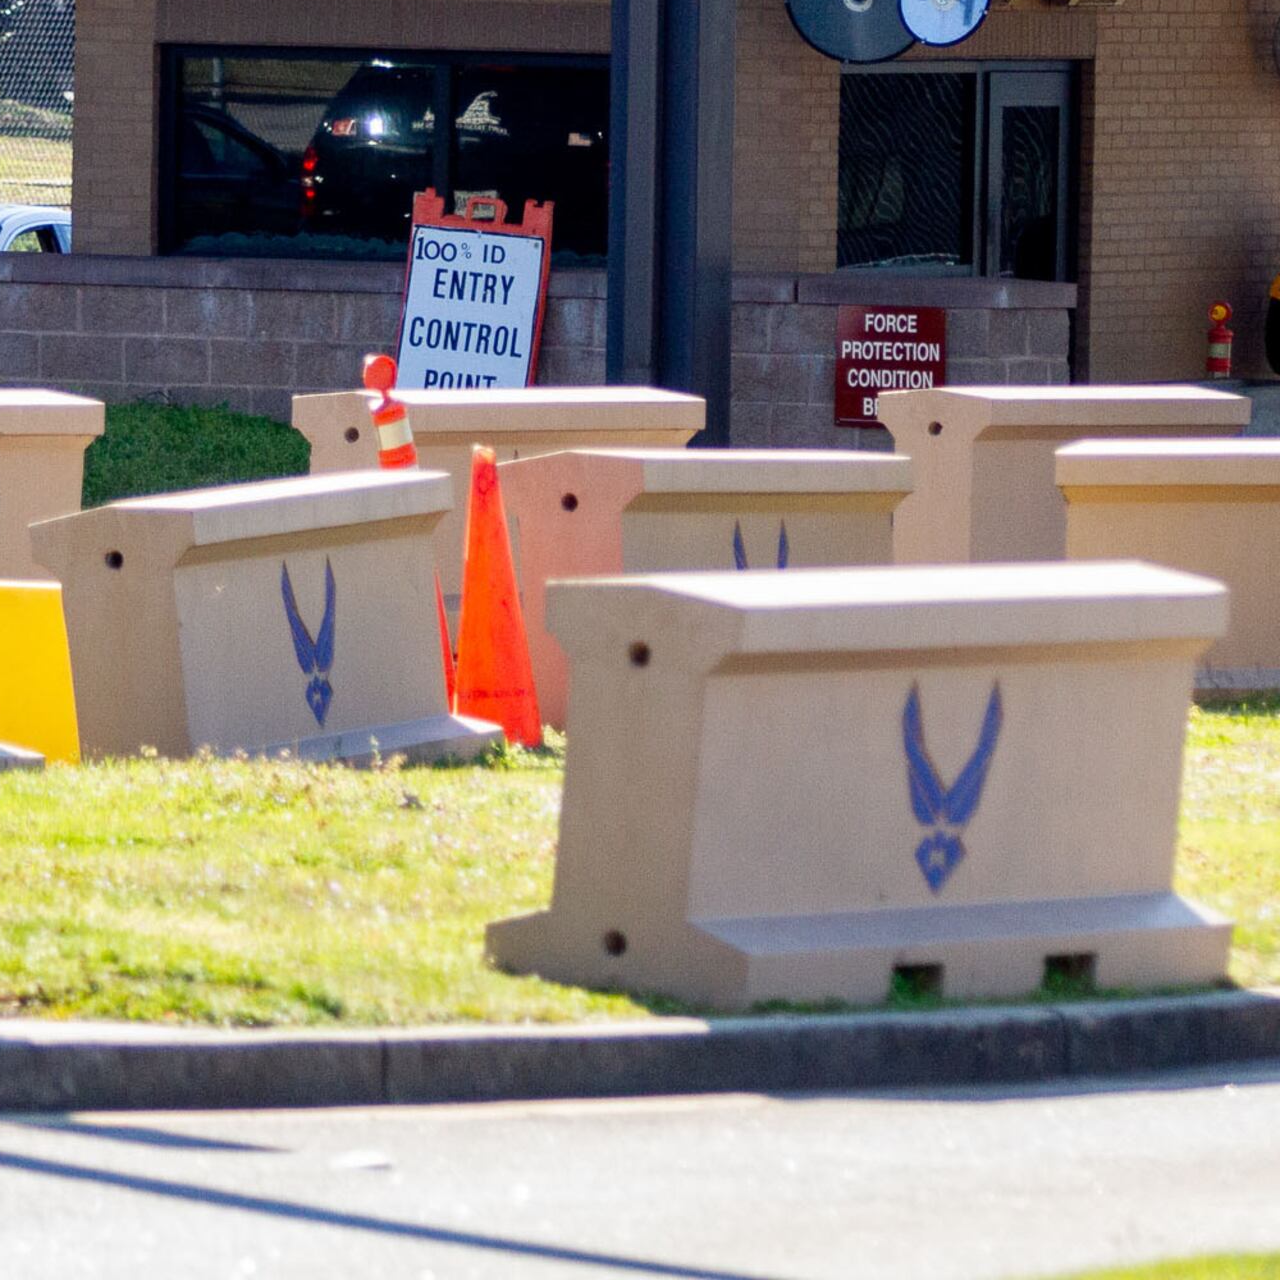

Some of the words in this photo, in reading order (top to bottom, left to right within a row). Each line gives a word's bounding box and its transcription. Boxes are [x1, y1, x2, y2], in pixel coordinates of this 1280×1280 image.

[482, 243, 507, 265] ID
[432, 268, 516, 306] ENTRY
[864, 313, 918, 333] FORCE
[408, 316, 523, 359] CONTROL
[841, 340, 941, 362] PROTECTION
[847, 368, 934, 390] CONDITION
